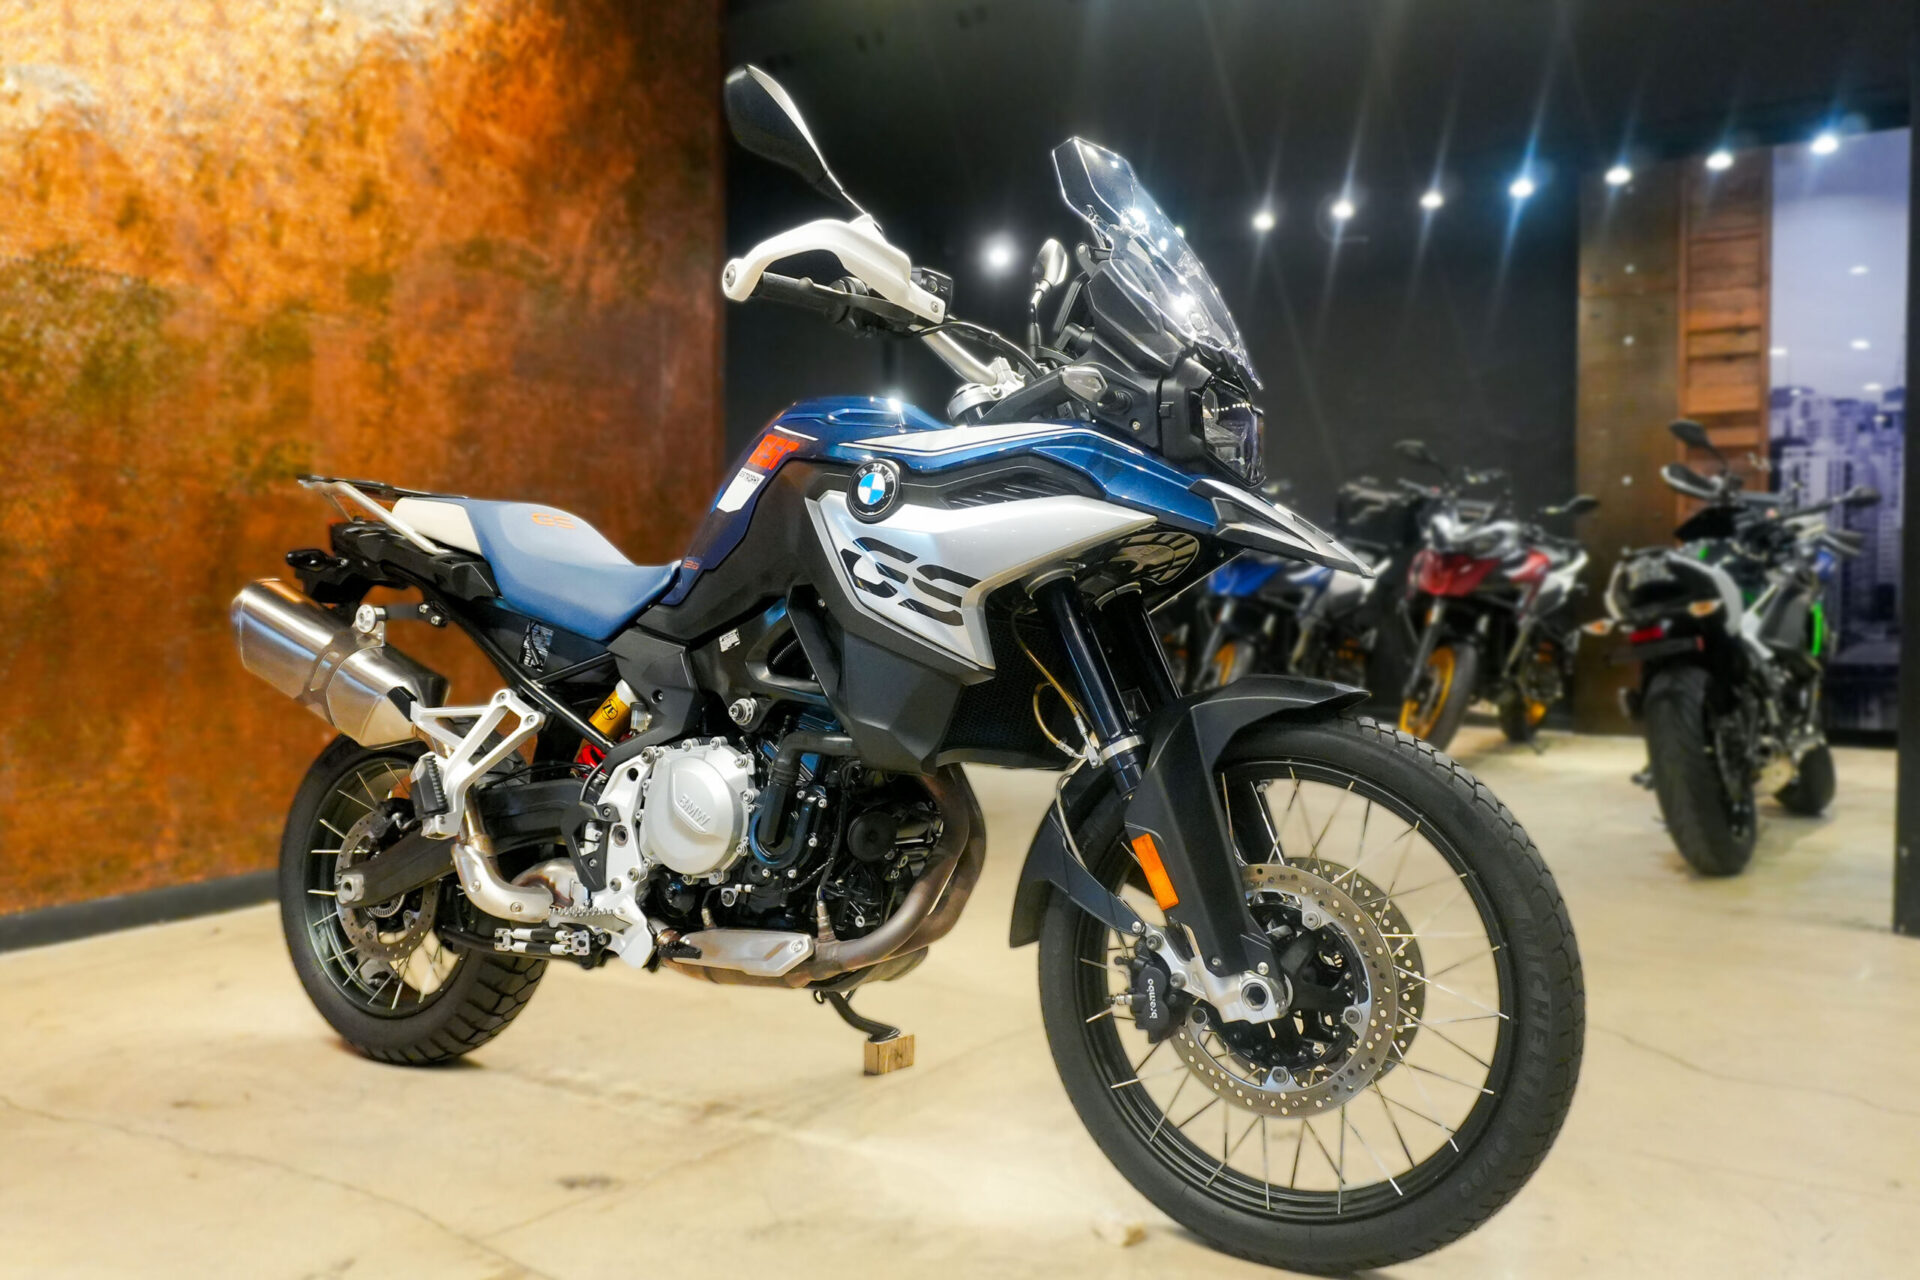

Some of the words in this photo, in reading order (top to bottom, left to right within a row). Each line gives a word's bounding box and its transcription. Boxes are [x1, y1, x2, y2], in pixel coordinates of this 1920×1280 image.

[857, 463, 894, 482] BMW
[531, 512, 576, 529] GS
[841, 537, 982, 627] GS
[679, 793, 711, 827] BMW
[1148, 978, 1158, 1019] brembo
